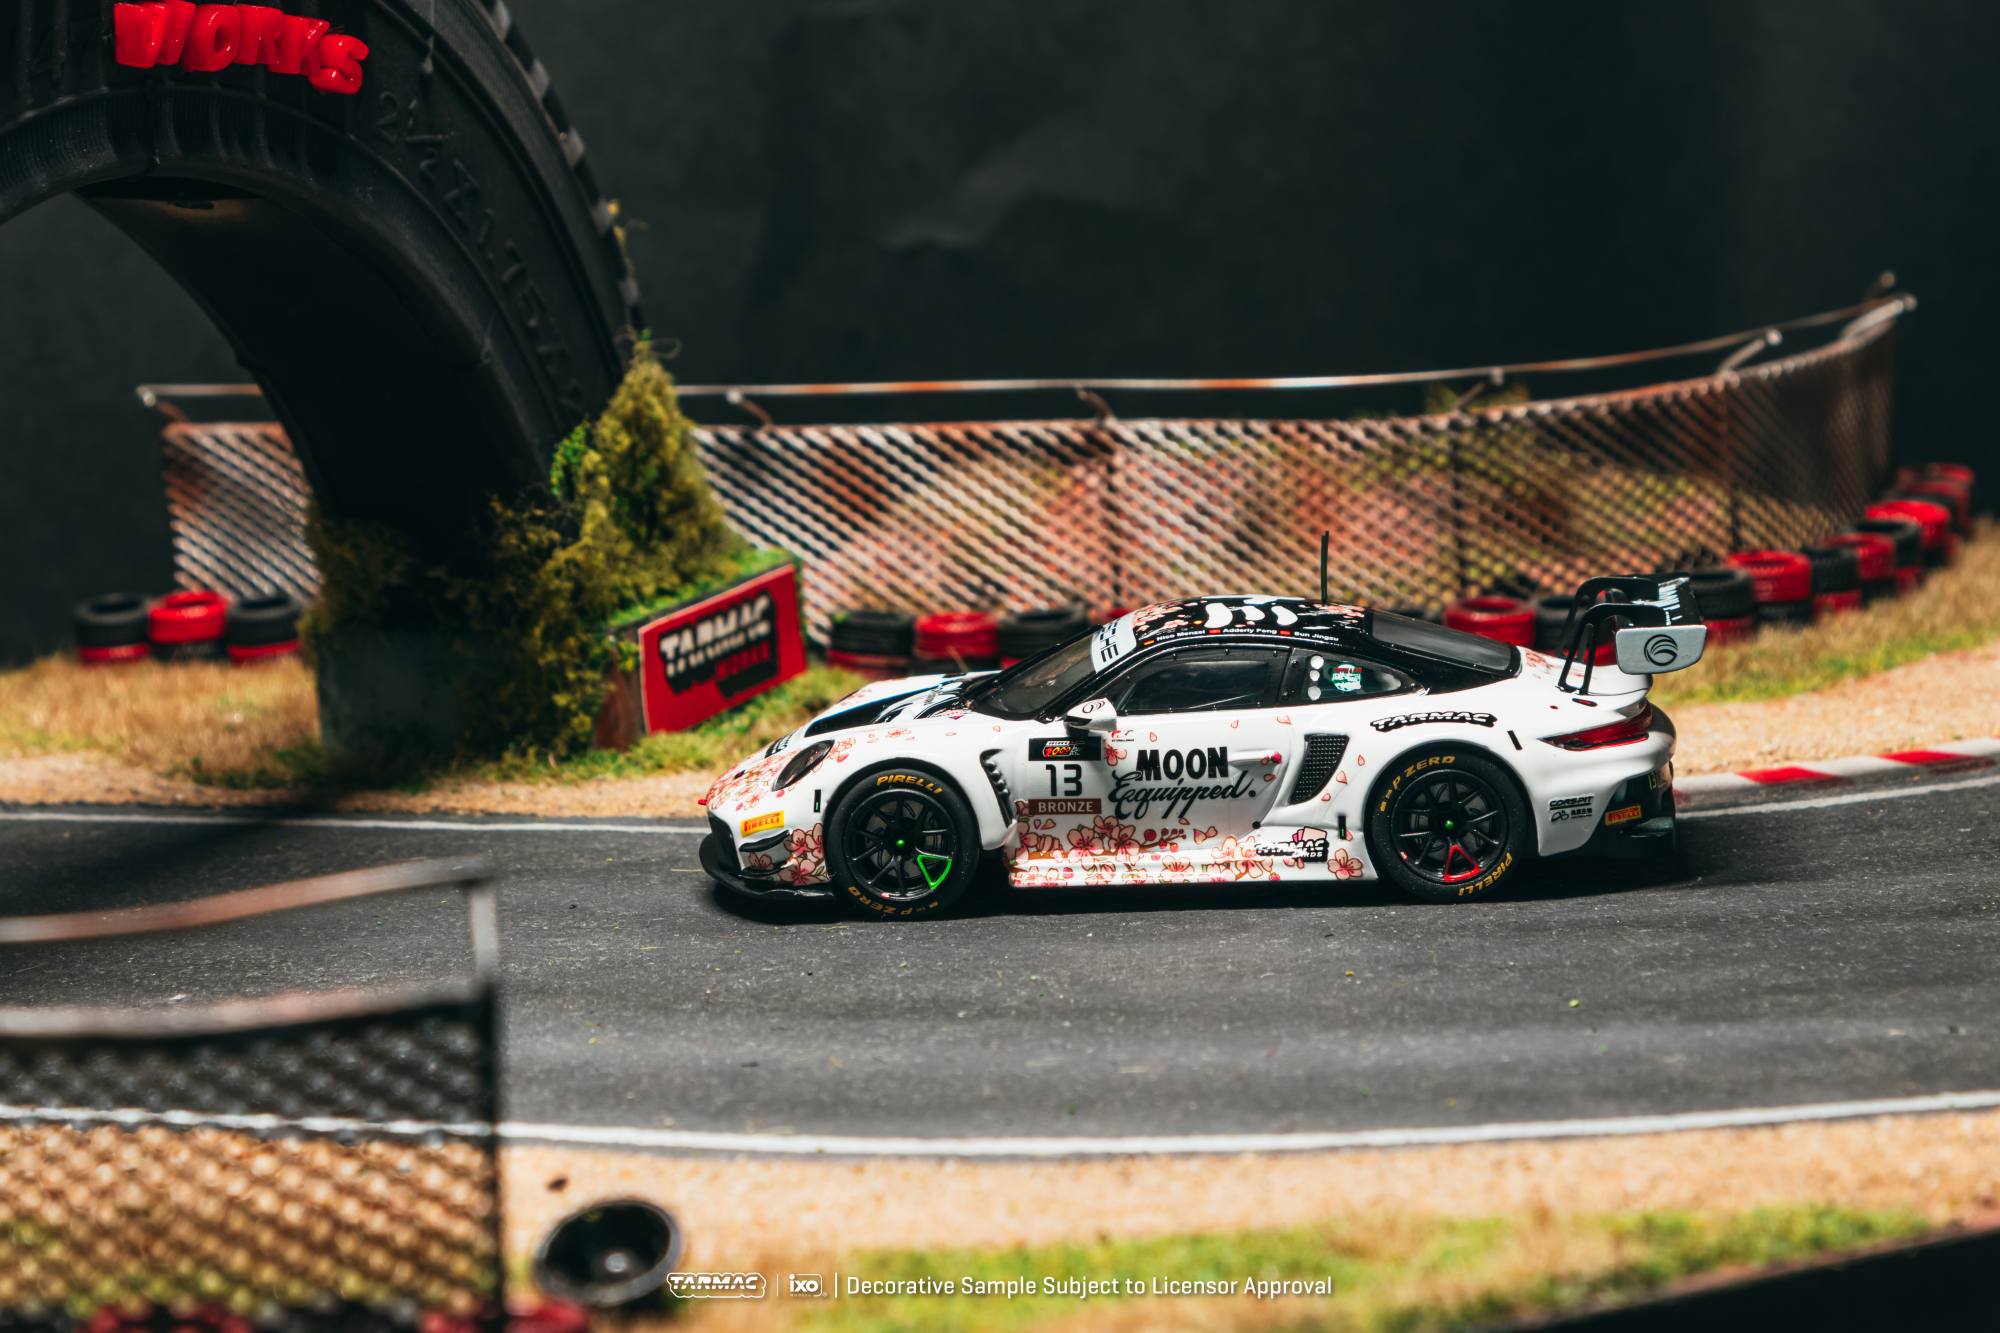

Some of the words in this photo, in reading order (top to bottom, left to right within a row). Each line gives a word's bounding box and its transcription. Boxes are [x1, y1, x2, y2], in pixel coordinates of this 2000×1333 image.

[113, 0, 369, 95] WORKS
[1372, 711, 1495, 731] TARMAC
[1136, 746, 1229, 782] MOON
[1404, 755, 1456, 778] ZERO
[876, 775, 944, 795] PIRELLI
[1045, 763, 1083, 797] 13
[1038, 801, 1094, 814] BRONZE
[744, 812, 781, 833] PIRELLI
[1459, 851, 1512, 897] PIRELLI
